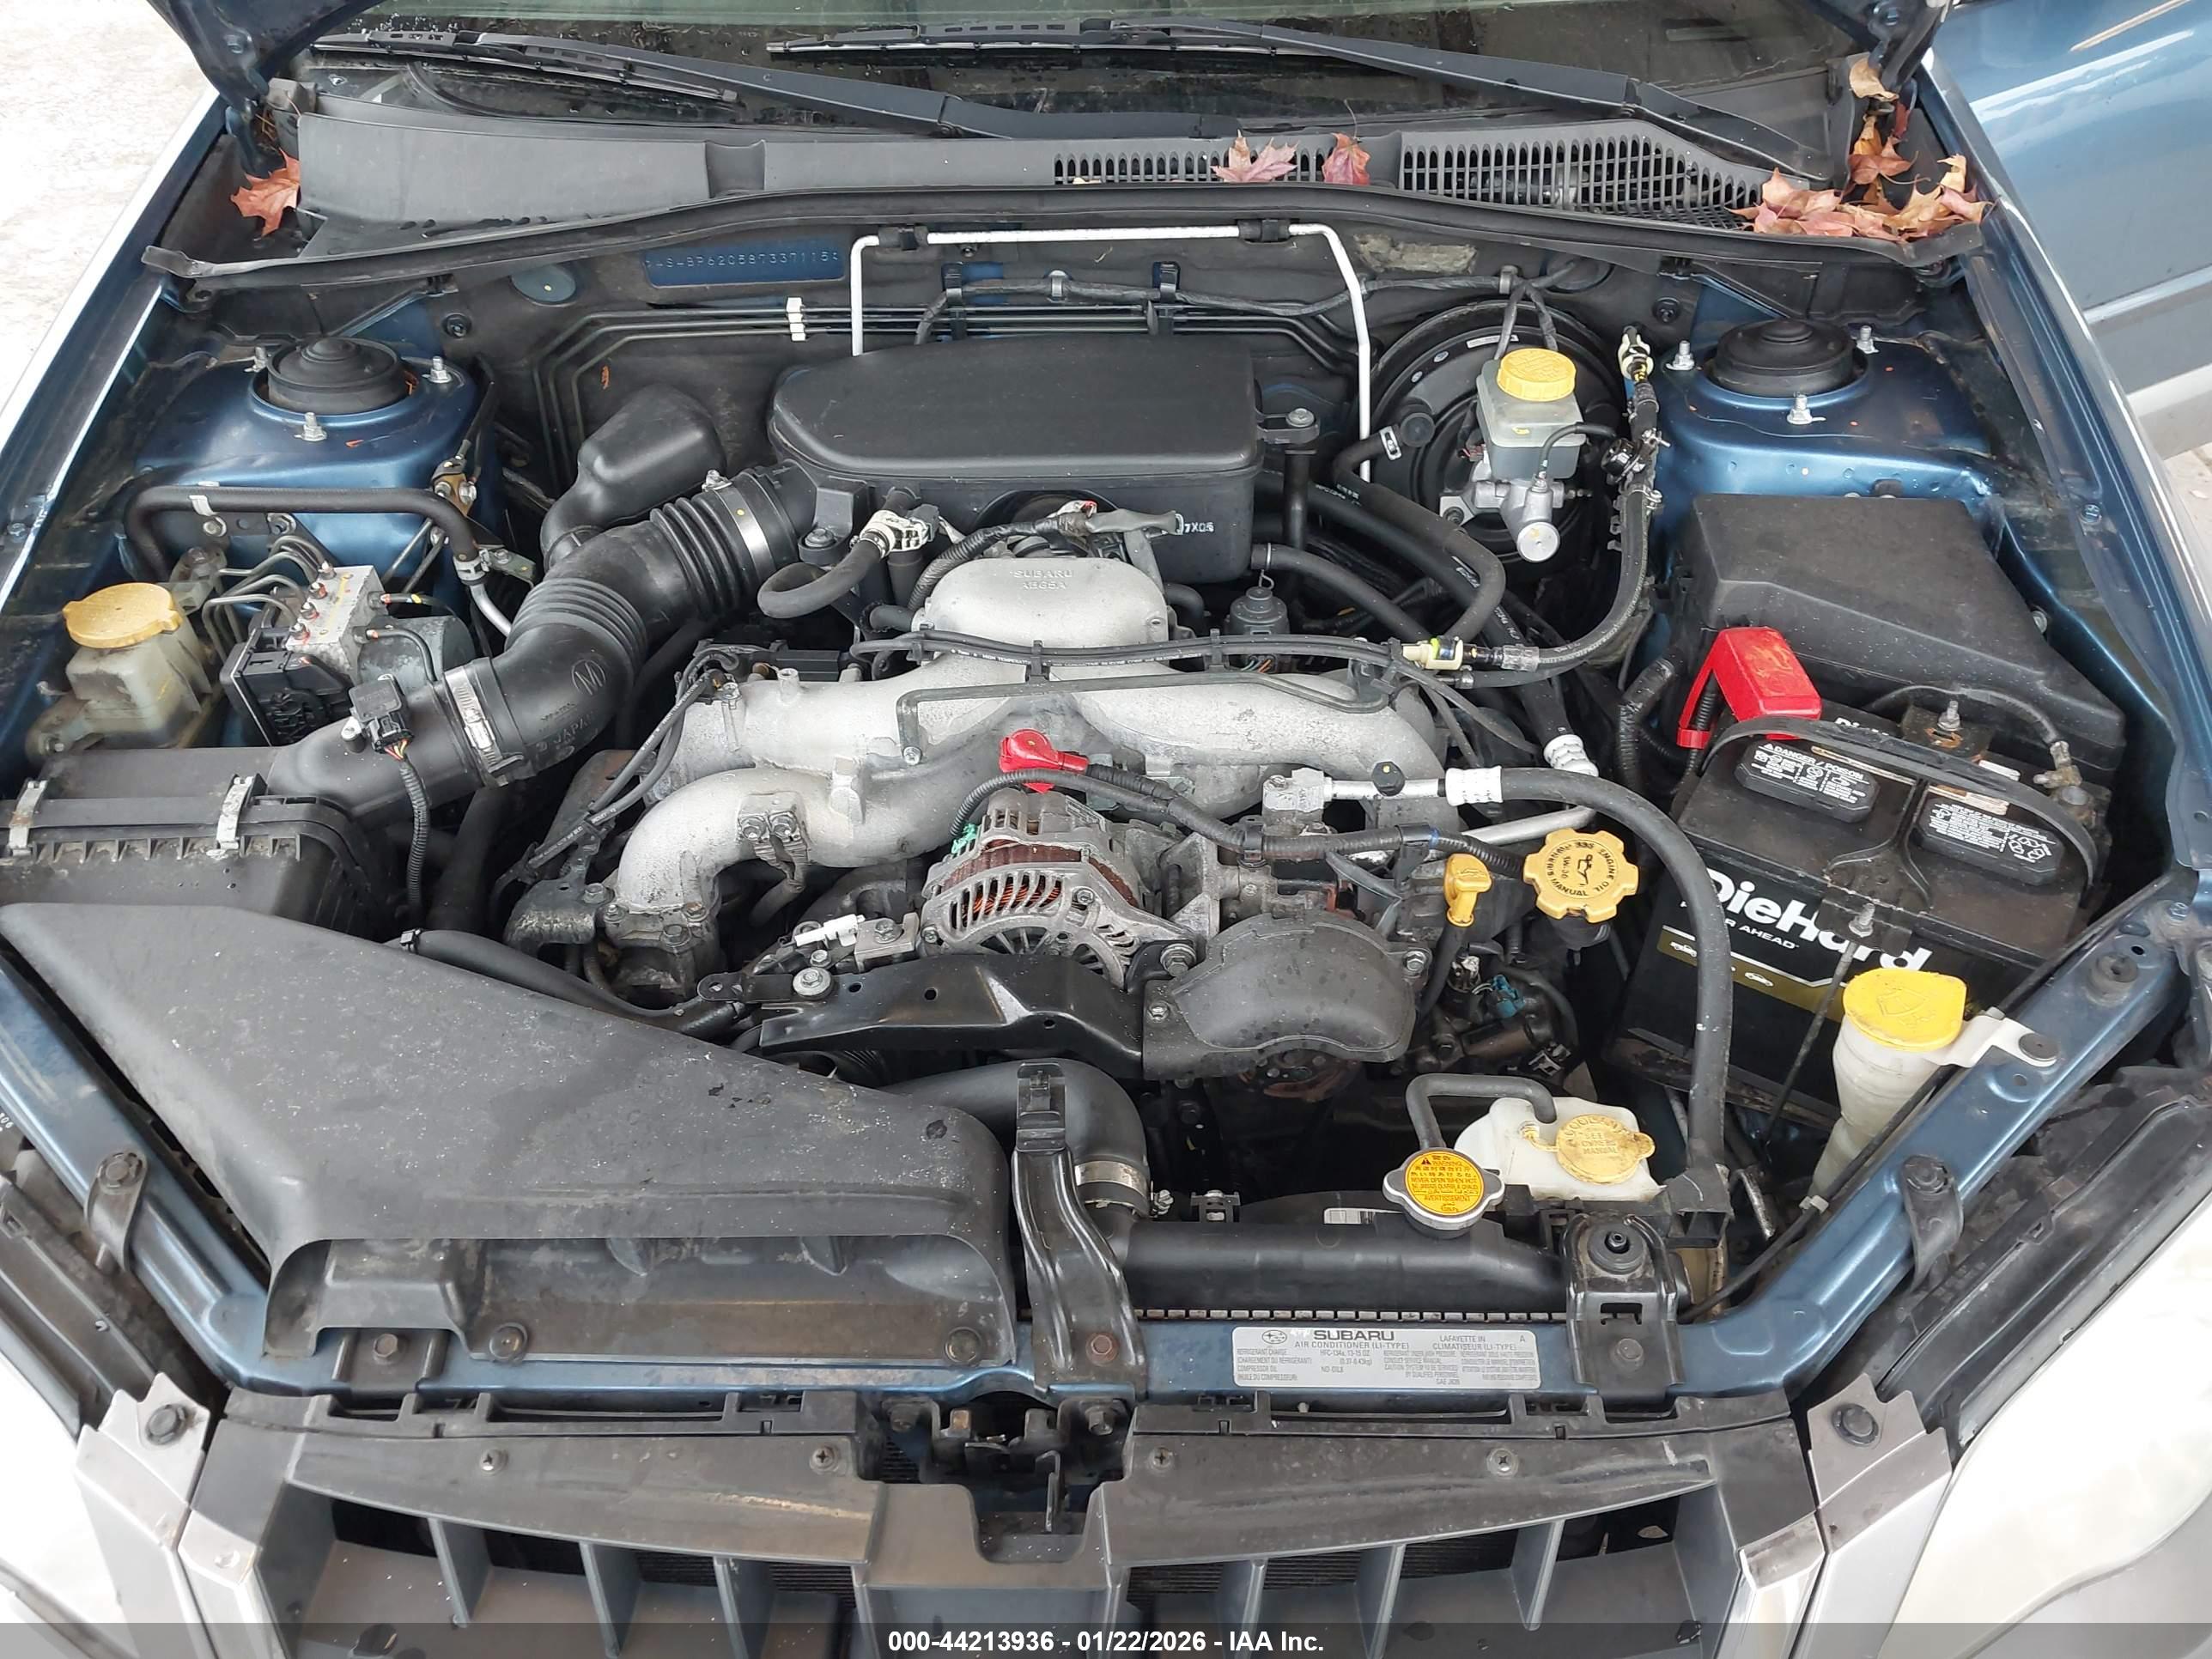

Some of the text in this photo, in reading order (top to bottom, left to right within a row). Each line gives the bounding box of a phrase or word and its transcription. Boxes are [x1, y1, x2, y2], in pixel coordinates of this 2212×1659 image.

[1772, 745, 1817, 765] DANGER
[1824, 763, 1864, 780] POISON
[1595, 848, 1616, 892] ENGINE OIL
[1550, 878, 1589, 896] MANUAL
[1738, 925, 1796, 950] AHEAD
[1314, 1330, 1395, 1340] SUBARU
[1432, 1342, 1482, 1351] CLIMATISEUR
